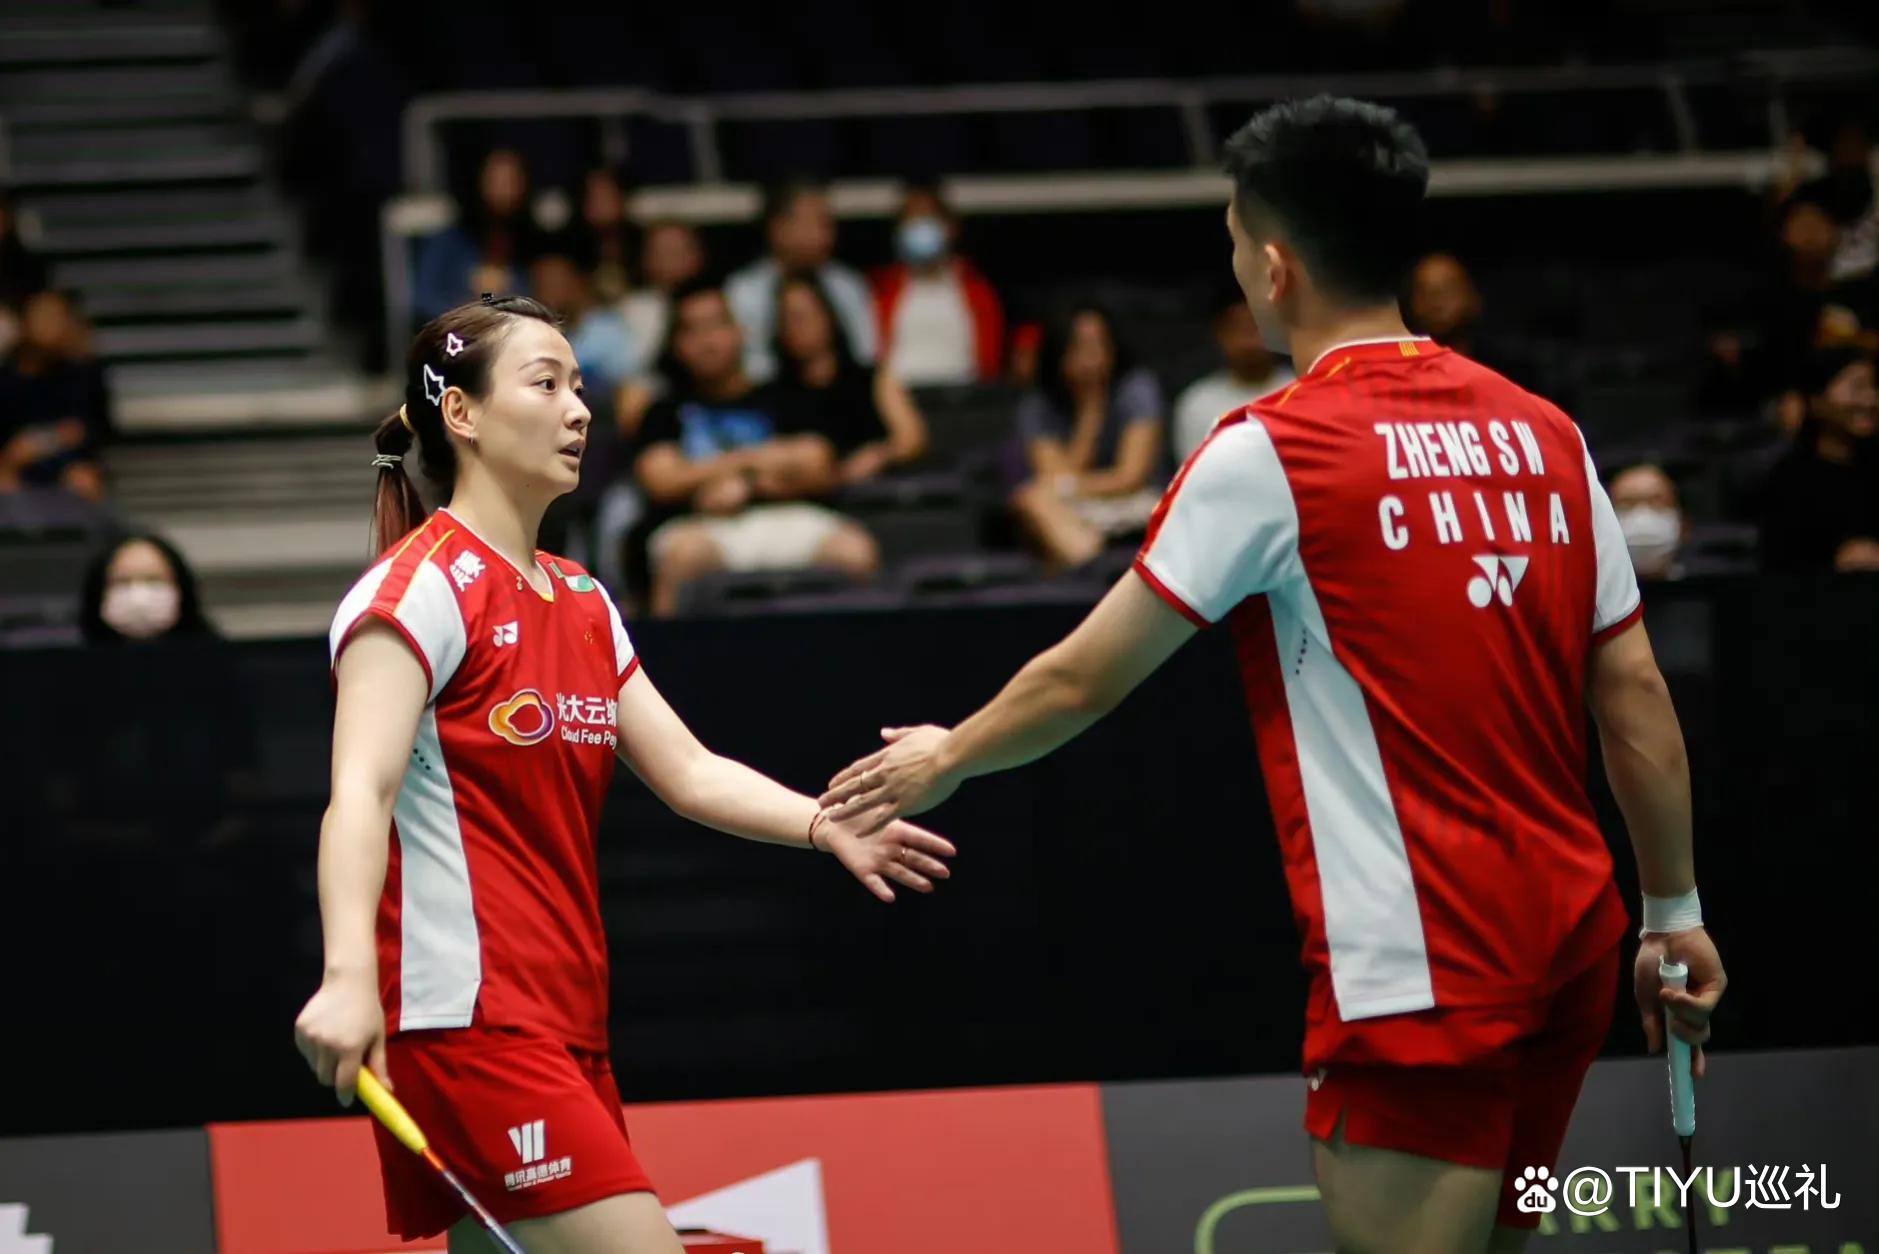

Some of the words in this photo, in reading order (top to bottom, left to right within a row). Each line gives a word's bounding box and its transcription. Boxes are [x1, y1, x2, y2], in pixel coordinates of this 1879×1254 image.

[1374, 420, 1491, 480] ZHENG
[1378, 491, 1570, 550] CHINA
[561, 724, 580, 743] Cloud
[581, 728, 602, 745] Fee
